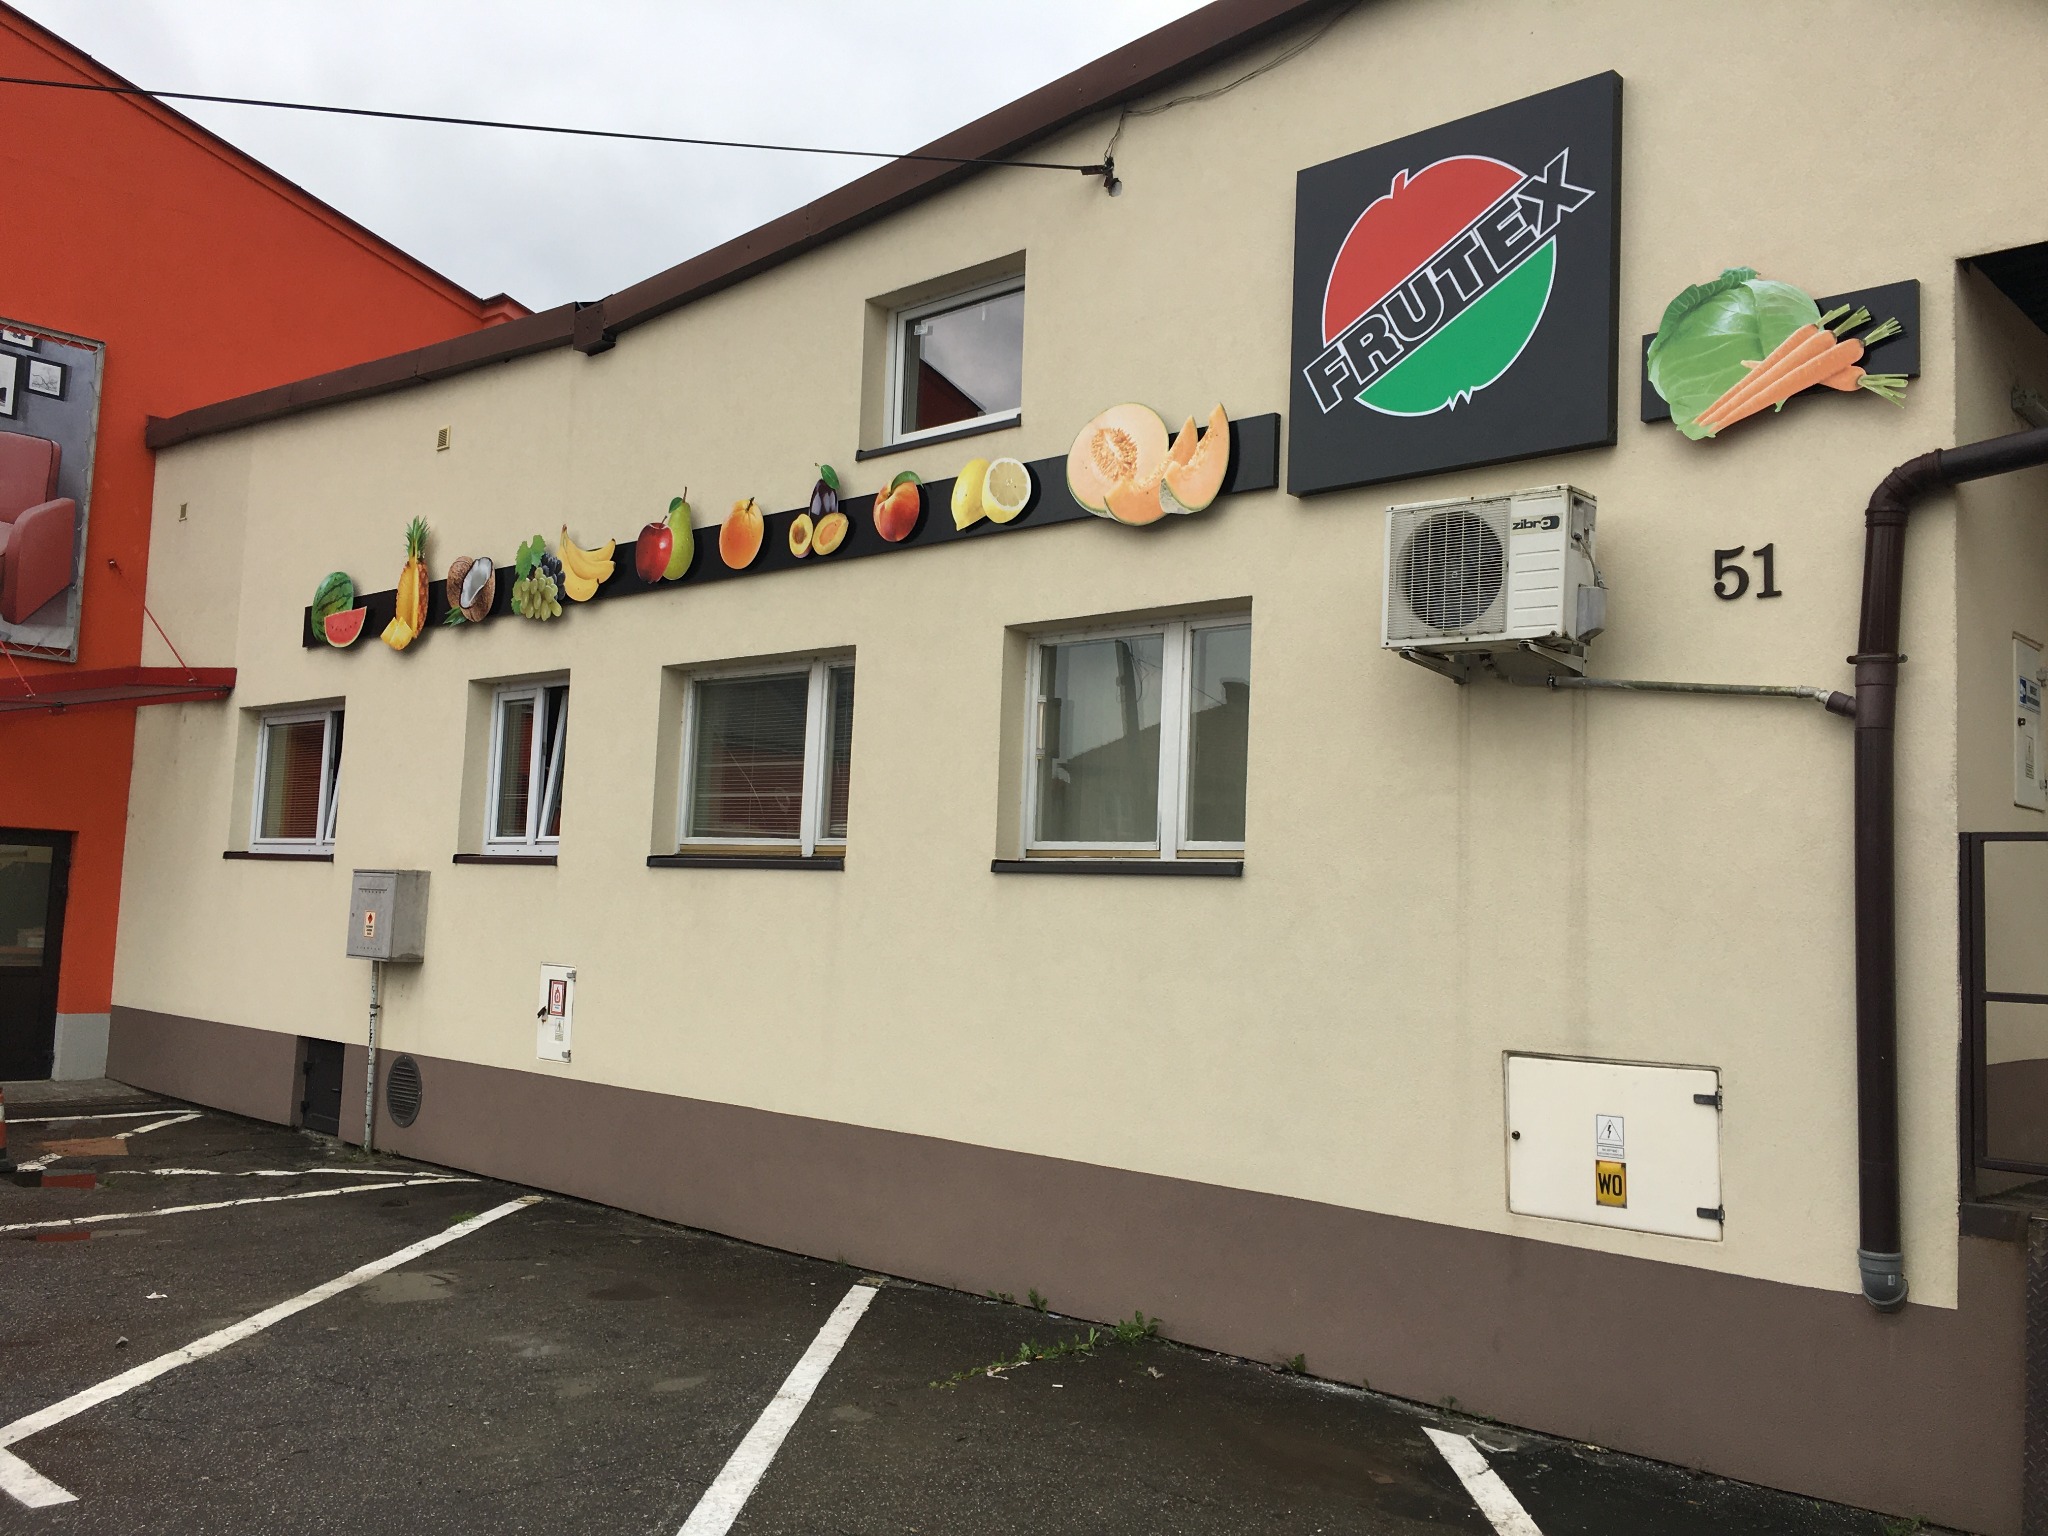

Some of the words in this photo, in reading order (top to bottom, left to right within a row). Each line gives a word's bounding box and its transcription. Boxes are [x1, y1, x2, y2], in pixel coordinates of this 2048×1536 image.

[1303, 147, 1596, 414] FRUTEX
[1512, 516, 1560, 530] zibro
[1714, 543, 1782, 600] 51
[1598, 1173, 1622, 1196] WO
